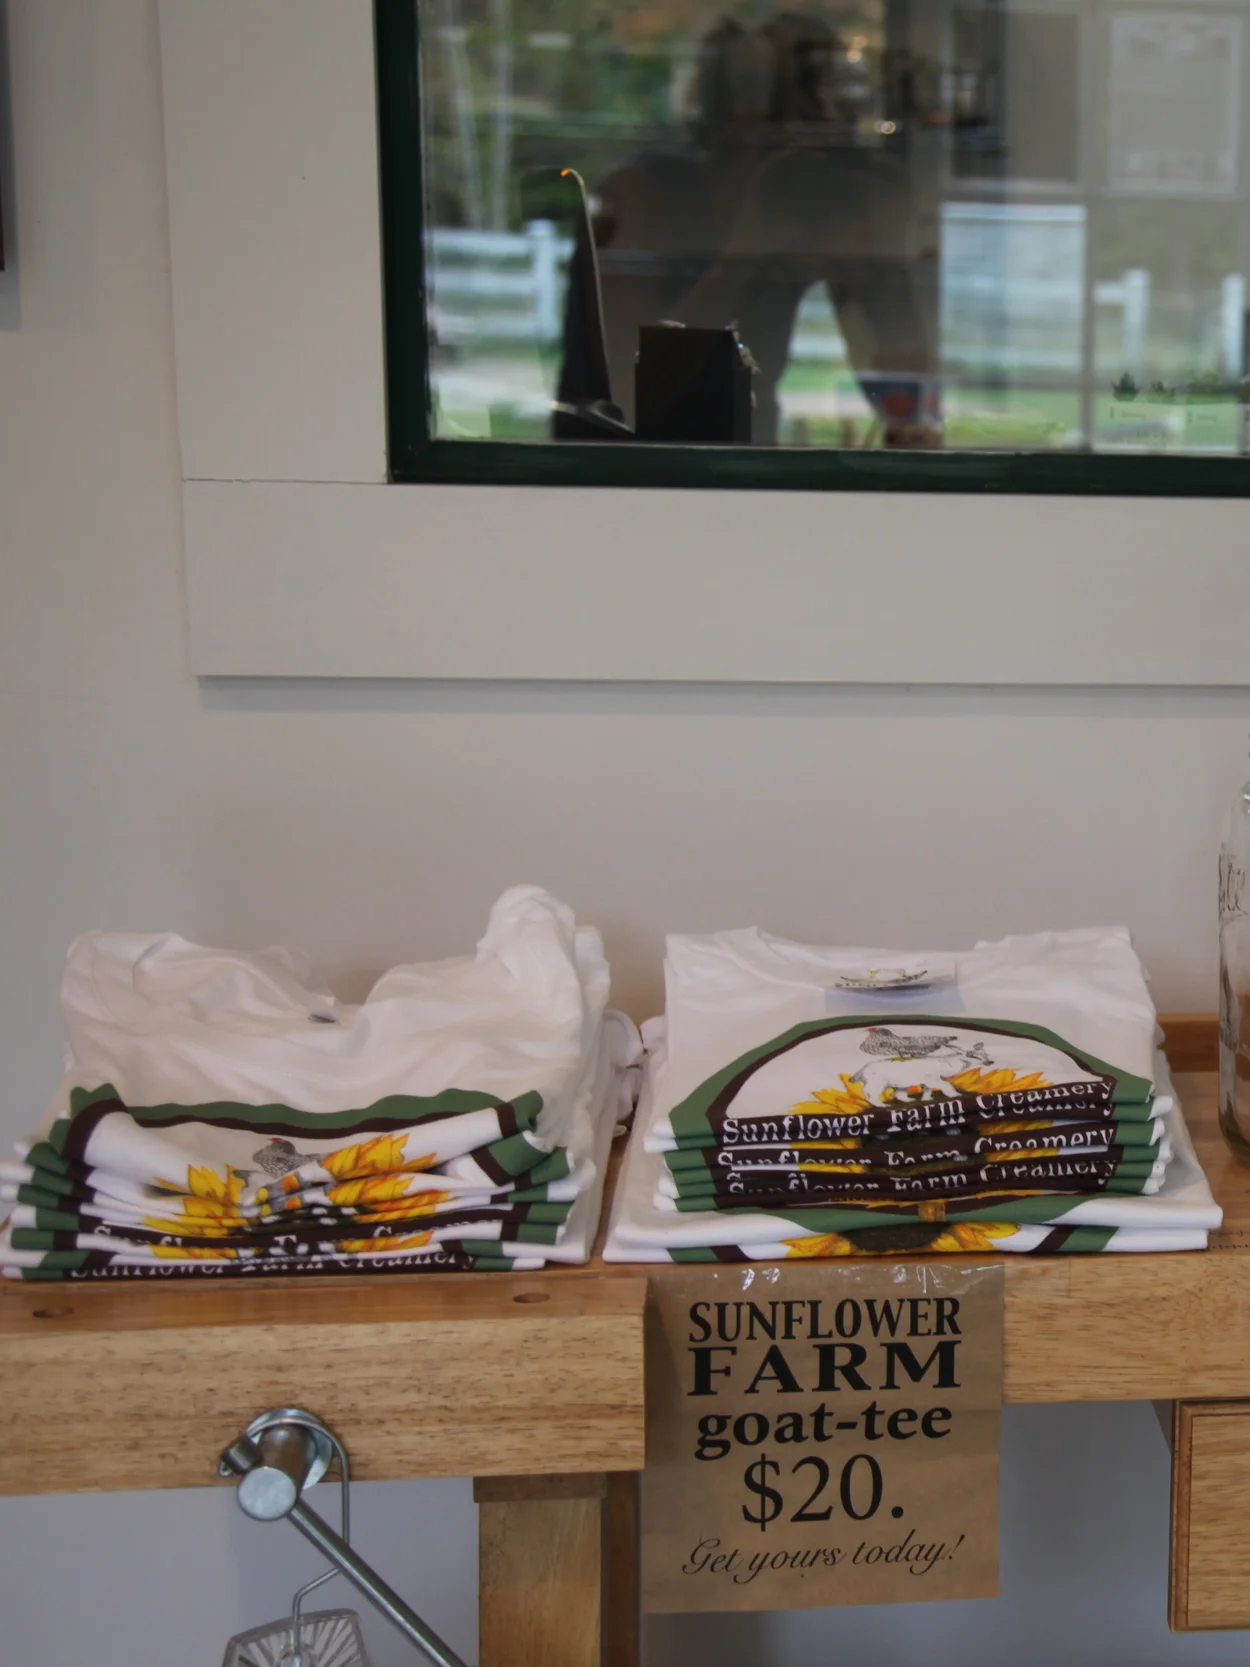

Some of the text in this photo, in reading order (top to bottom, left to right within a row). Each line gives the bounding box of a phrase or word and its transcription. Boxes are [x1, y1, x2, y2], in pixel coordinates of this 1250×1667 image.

[722, 1113, 875, 1144] Sunflower
[887, 1098, 967, 1133] Farm
[975, 1082, 1113, 1110] Creamery
[689, 1297, 962, 1343] SUNFLOWER
[687, 1340, 962, 1396] FARM
[694, 1401, 953, 1461] goat-tee
[742, 1453, 904, 1532] $20.
[681, 1529, 966, 1585] Get yours today!
